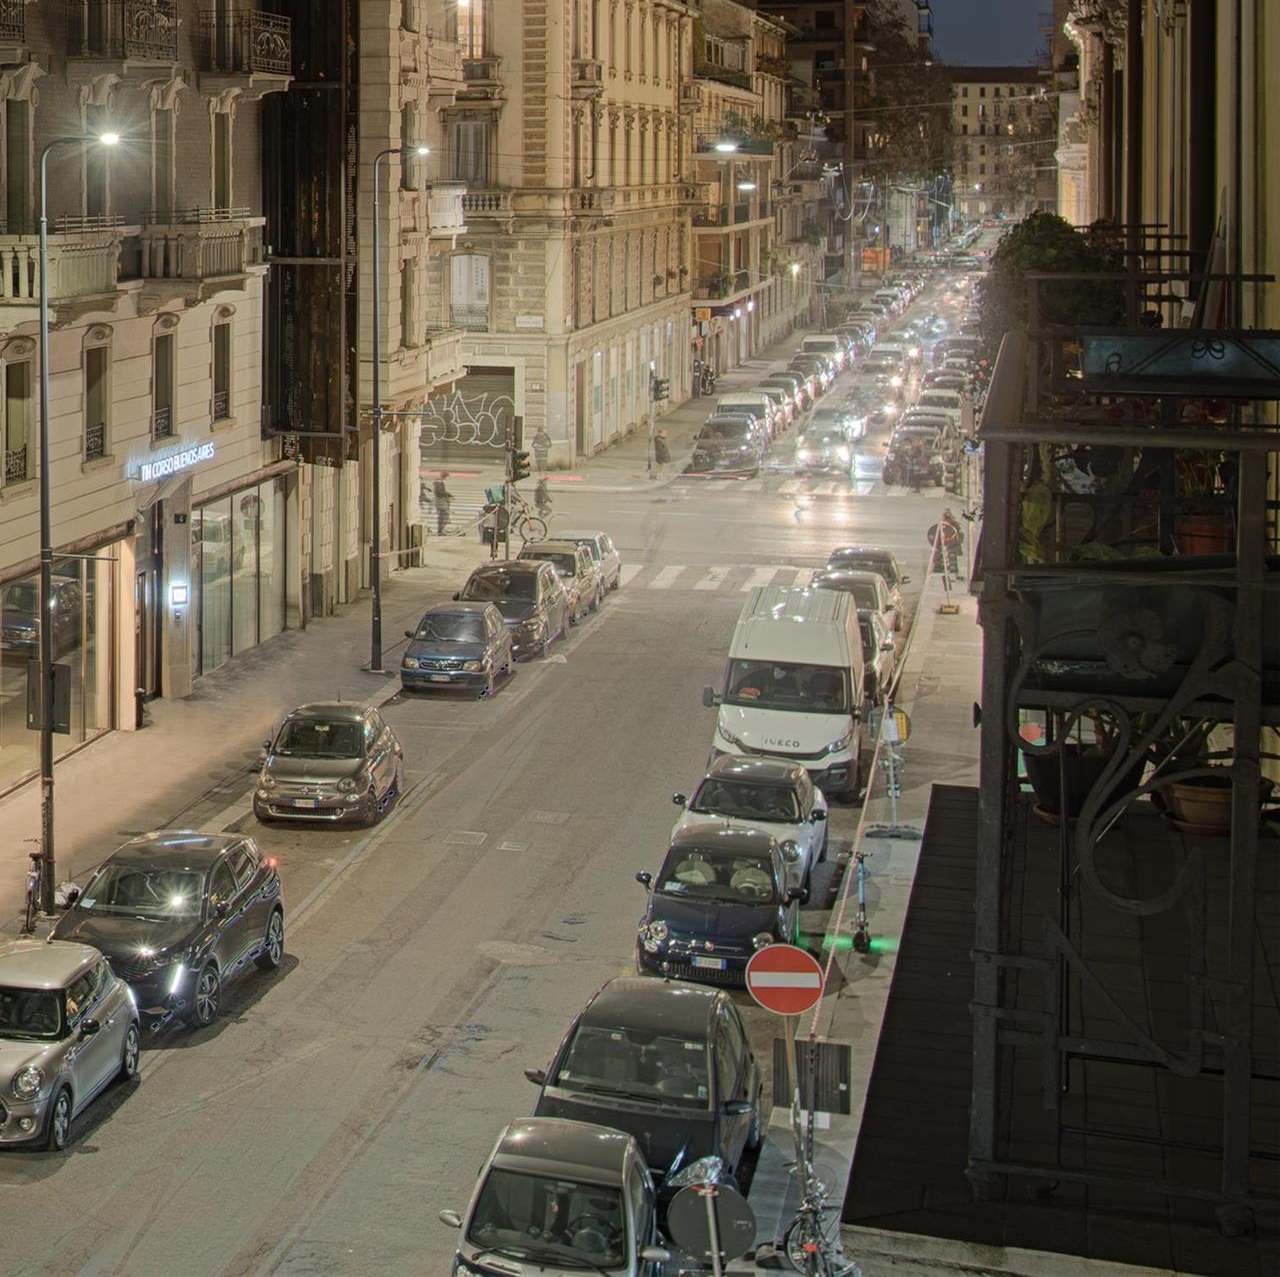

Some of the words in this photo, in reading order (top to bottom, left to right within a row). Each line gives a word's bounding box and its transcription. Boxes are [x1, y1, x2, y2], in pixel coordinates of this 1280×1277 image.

[152, 457, 174, 479] CORSO
[174, 448, 197, 471] BUENOS
[197, 442, 215, 462] AIRES
[764, 738, 801, 748] IVECO
